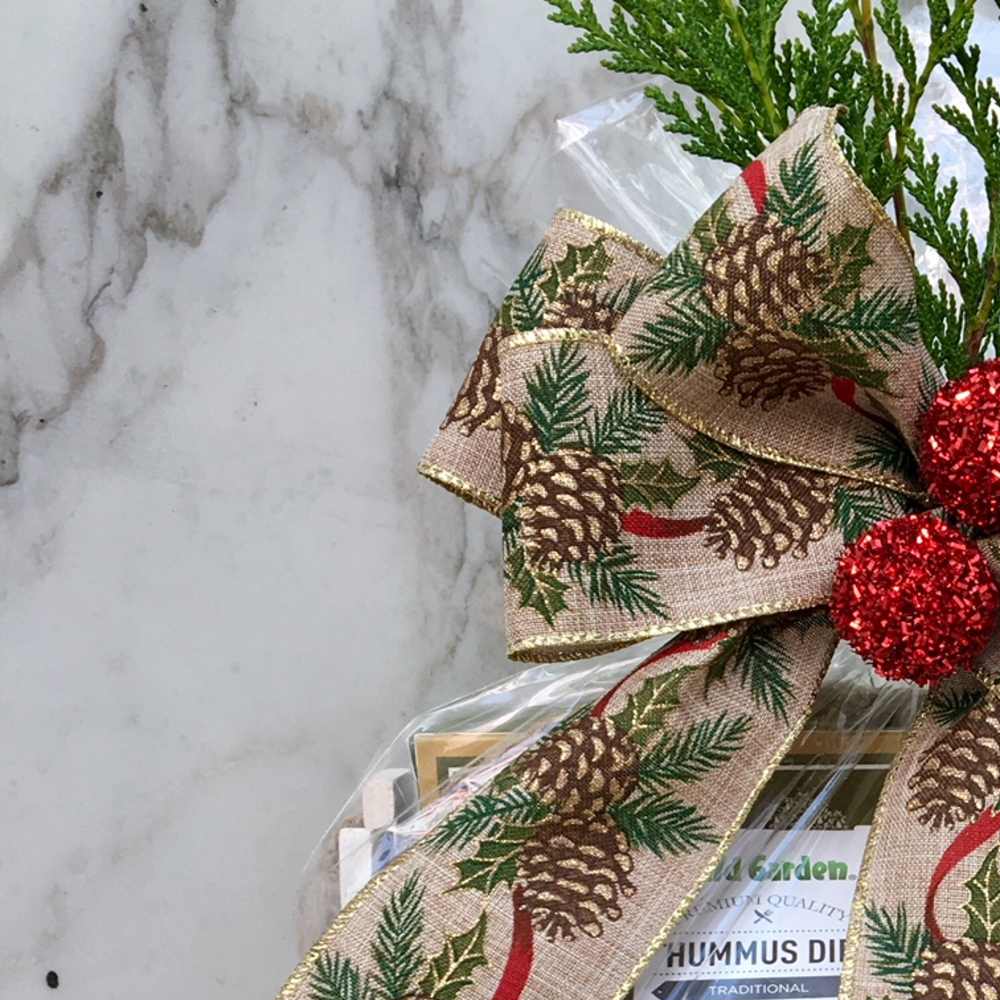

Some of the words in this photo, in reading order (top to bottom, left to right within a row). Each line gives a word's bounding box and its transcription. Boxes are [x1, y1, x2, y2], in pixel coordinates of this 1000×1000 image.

[768, 894, 847, 921] QUALITY
[666, 940, 798, 967] HUMMUS
[709, 983, 809, 995] TRADITIONAL
